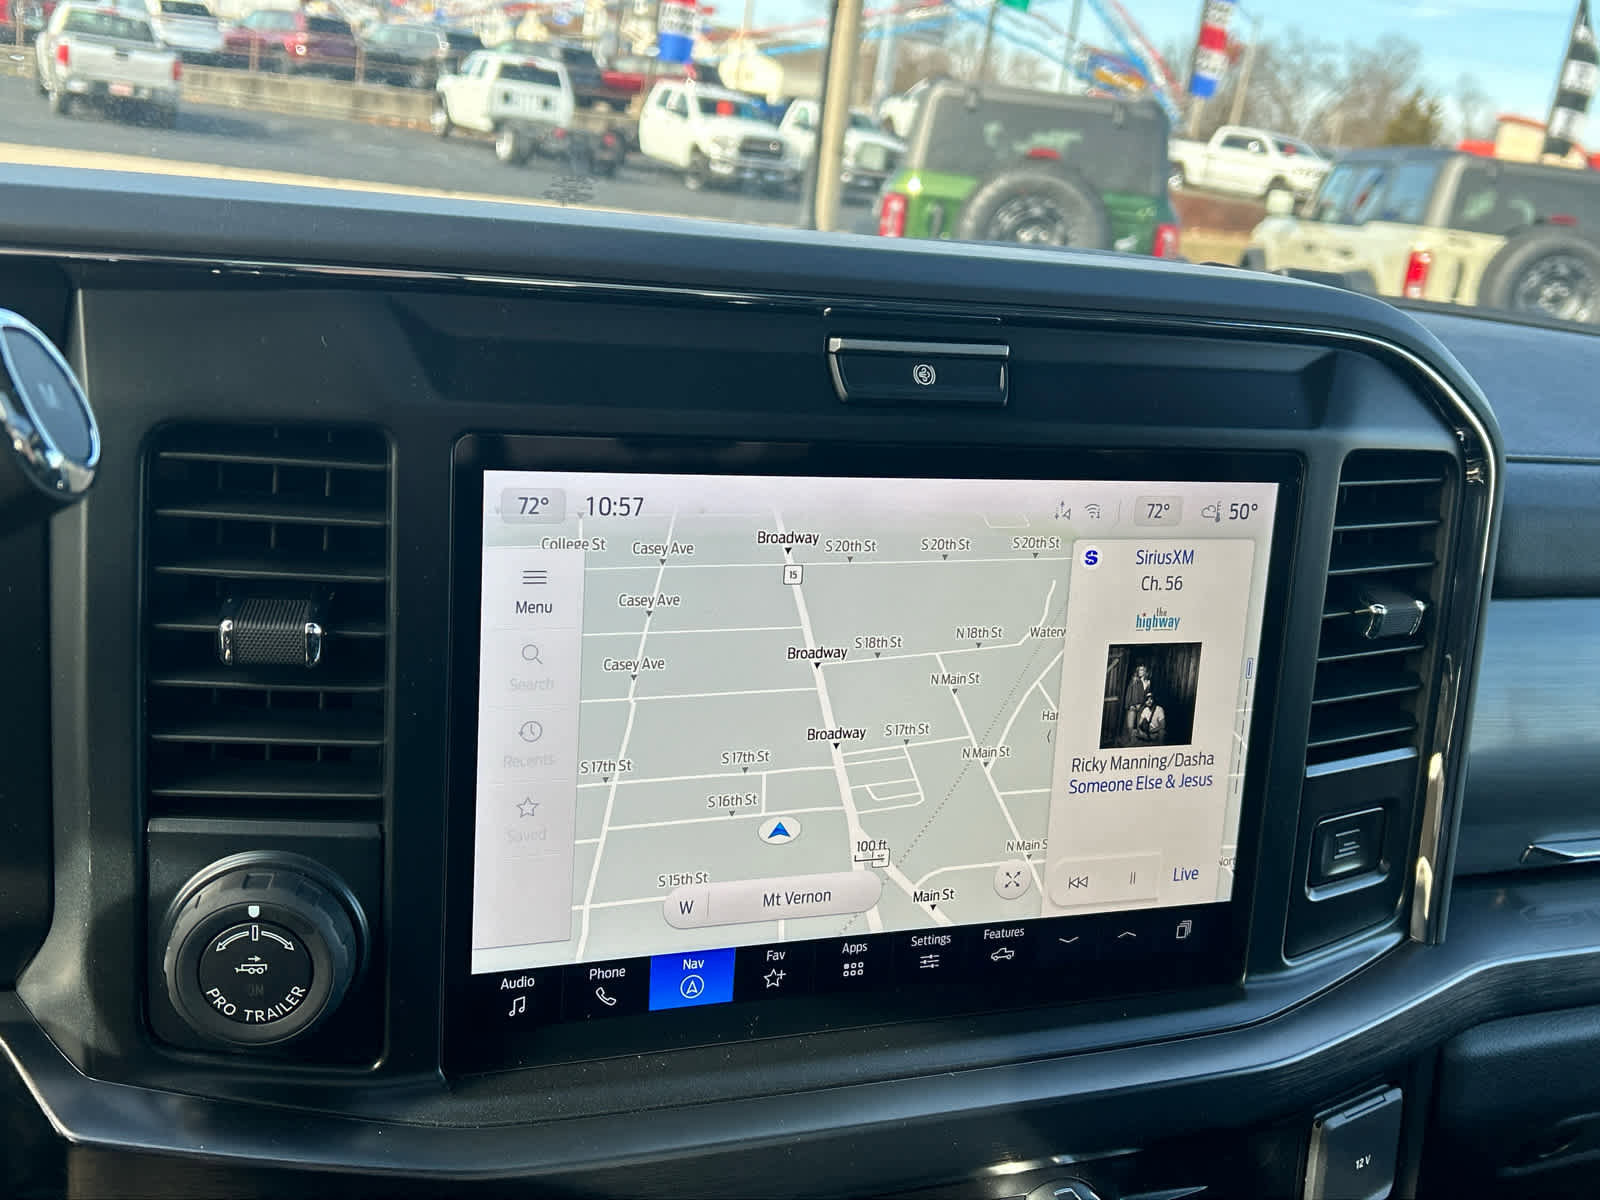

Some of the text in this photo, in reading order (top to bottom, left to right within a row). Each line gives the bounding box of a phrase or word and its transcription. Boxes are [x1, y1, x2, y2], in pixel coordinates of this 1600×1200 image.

[518, 497, 549, 515] 72°
[586, 496, 644, 517] 10:57
[1148, 504, 1170, 519] 72°
[1229, 504, 1258, 520] 50°
[592, 538, 606, 550] St
[757, 531, 819, 546] Broadway
[921, 539, 971, 551] S 20th St
[1013, 538, 1060, 549] S 20th St
[633, 542, 694, 557] Casey Ave
[826, 540, 877, 552] S 20th St
[1136, 550, 1194, 565] SiriusXM
[789, 571, 798, 580] 15
[1141, 576, 1183, 591] Ch. 56
[515, 601, 553, 614] Menu
[619, 594, 680, 608] Casey Ave
[1156, 607, 1168, 617] the
[1136, 614, 1181, 631] highway
[957, 627, 1002, 639] N 18th St
[855, 637, 902, 649] S 18th St
[787, 647, 848, 661] Broadway
[604, 658, 665, 672] Casey Ave
[930, 673, 980, 685] N Main St
[807, 727, 867, 742] Broadway
[885, 724, 929, 736] S 17th St
[722, 750, 770, 764] S 17th St
[962, 746, 1010, 759] N Main St
[580, 759, 632, 773] S 17th St
[1072, 752, 1215, 774] Ricky Manning/Dasha
[1069, 773, 1213, 794] Someone Else & Jesus
[708, 794, 758, 808] S 16th St
[857, 839, 888, 852] 100 ft
[1006, 840, 1015, 851] N
[1017, 840, 1041, 851] Main
[658, 873, 709, 888] S 15th St
[1173, 867, 1199, 882] Live
[763, 890, 832, 908] Mt Vernon
[913, 889, 955, 903] Main St
[679, 900, 693, 914] W
[983, 926, 1025, 941] Features
[911, 933, 952, 949] Settings
[767, 950, 786, 962] Fav
[842, 942, 868, 956] Apps
[683, 958, 705, 971] Nav
[590, 967, 626, 982] Phone
[500, 976, 535, 990] Audio
[206, 985, 307, 1023] PRO TRAILER
